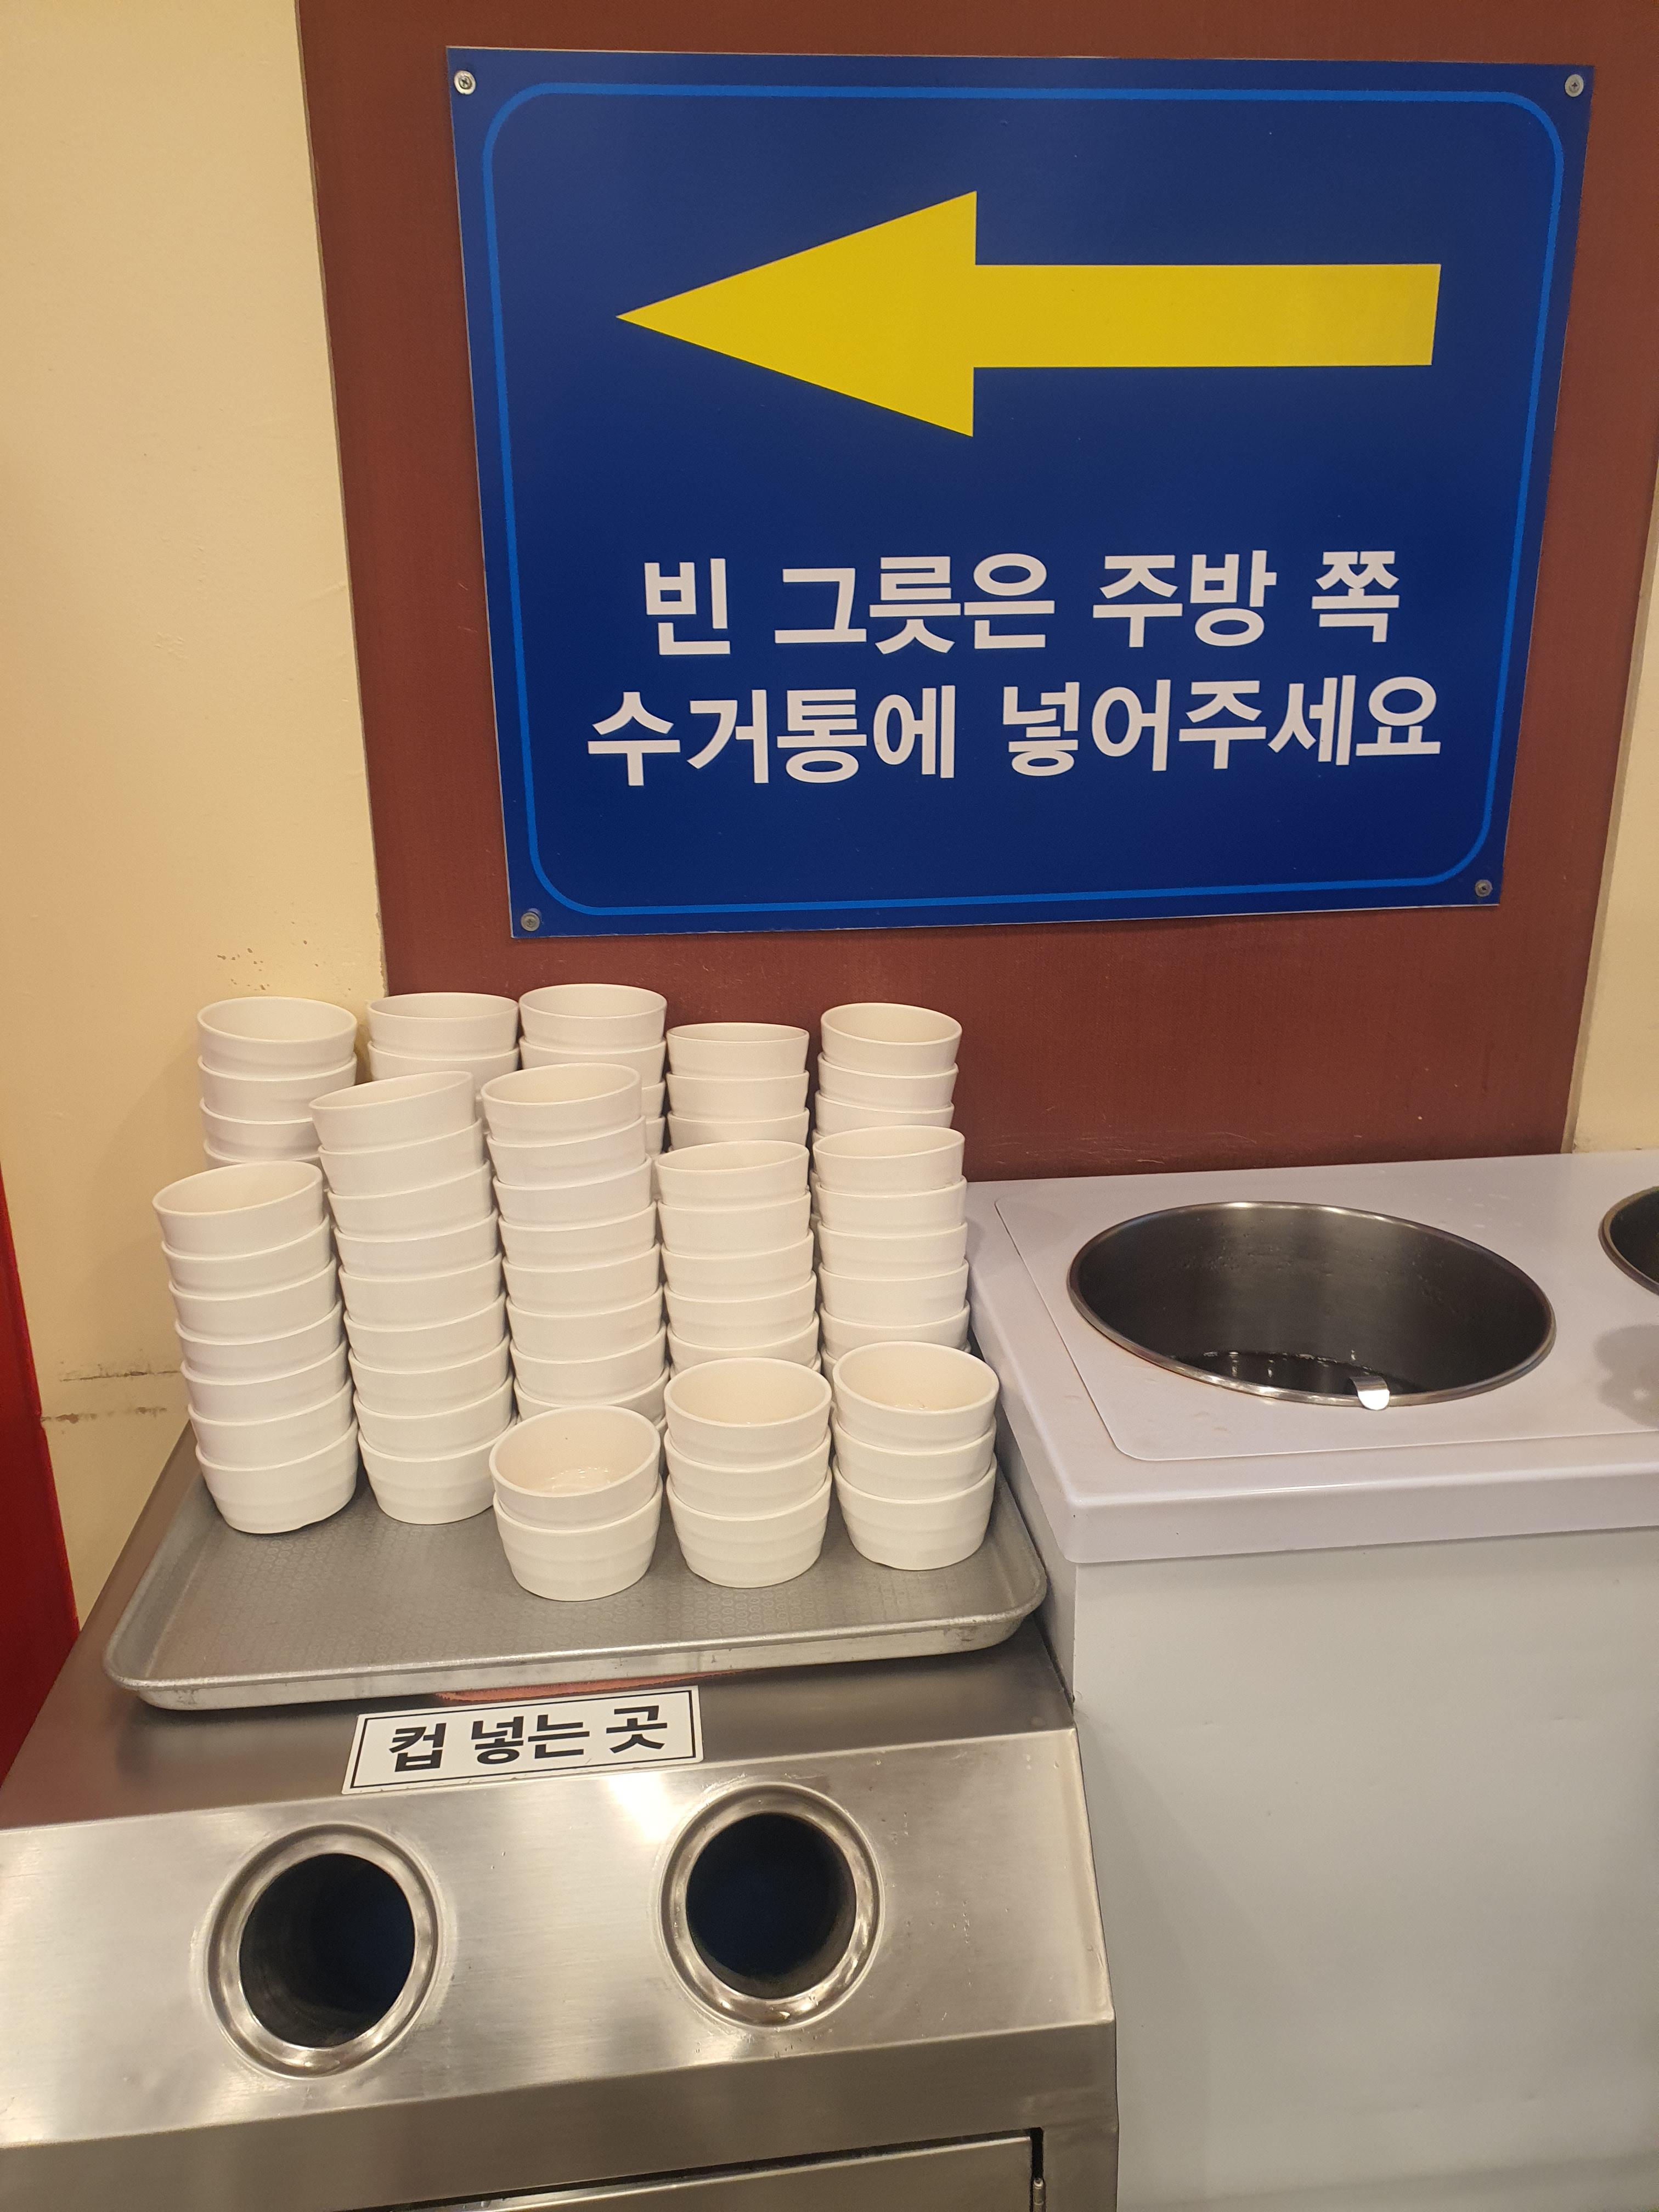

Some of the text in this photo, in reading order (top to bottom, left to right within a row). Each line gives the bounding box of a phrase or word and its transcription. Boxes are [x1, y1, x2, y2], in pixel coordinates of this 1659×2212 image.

[645, 550, 1400, 656] 빈 그릇은 주방 쪽
[587, 675, 1441, 787] 수거통에 넣어주세요
[388, 1705, 668, 1773] 컵 넣는 곳
